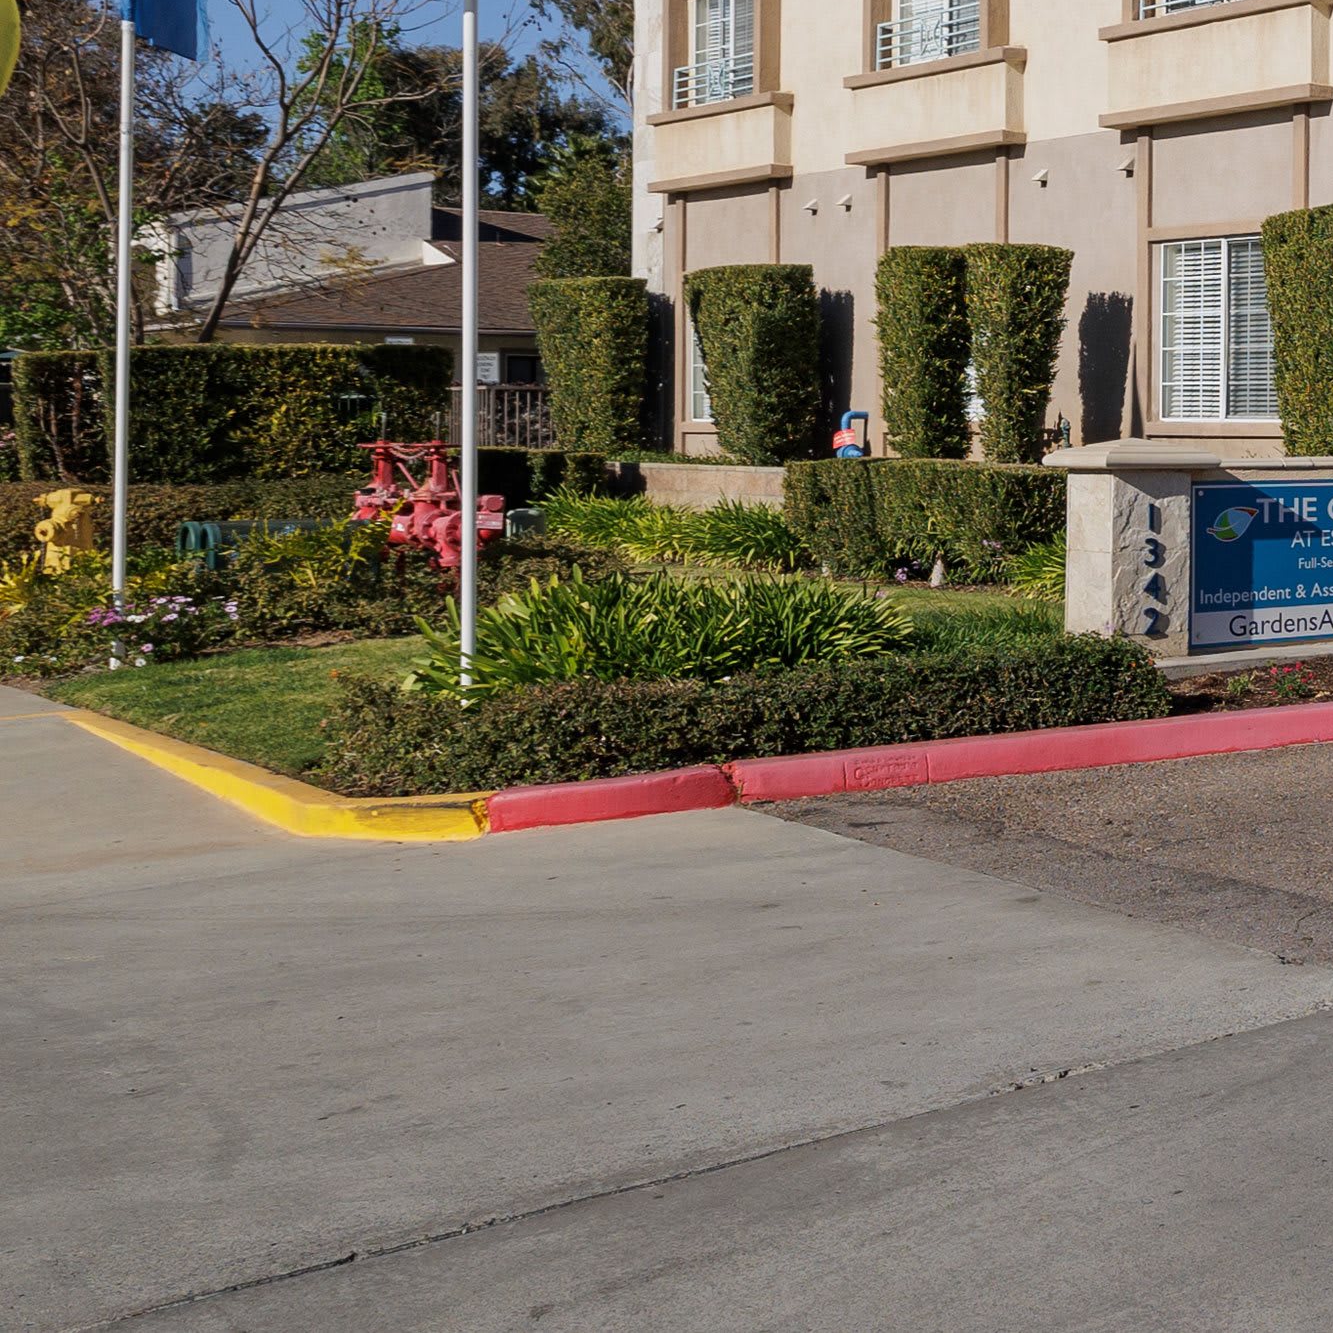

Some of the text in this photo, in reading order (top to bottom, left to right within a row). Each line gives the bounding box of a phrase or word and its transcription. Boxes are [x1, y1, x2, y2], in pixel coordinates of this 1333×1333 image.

[1256, 497, 1318, 523] THE
[1291, 530, 1316, 548] AT
[1143, 503, 1161, 635] 1342
[1200, 586, 1292, 607] Independent
[1295, 584, 1306, 598] &
